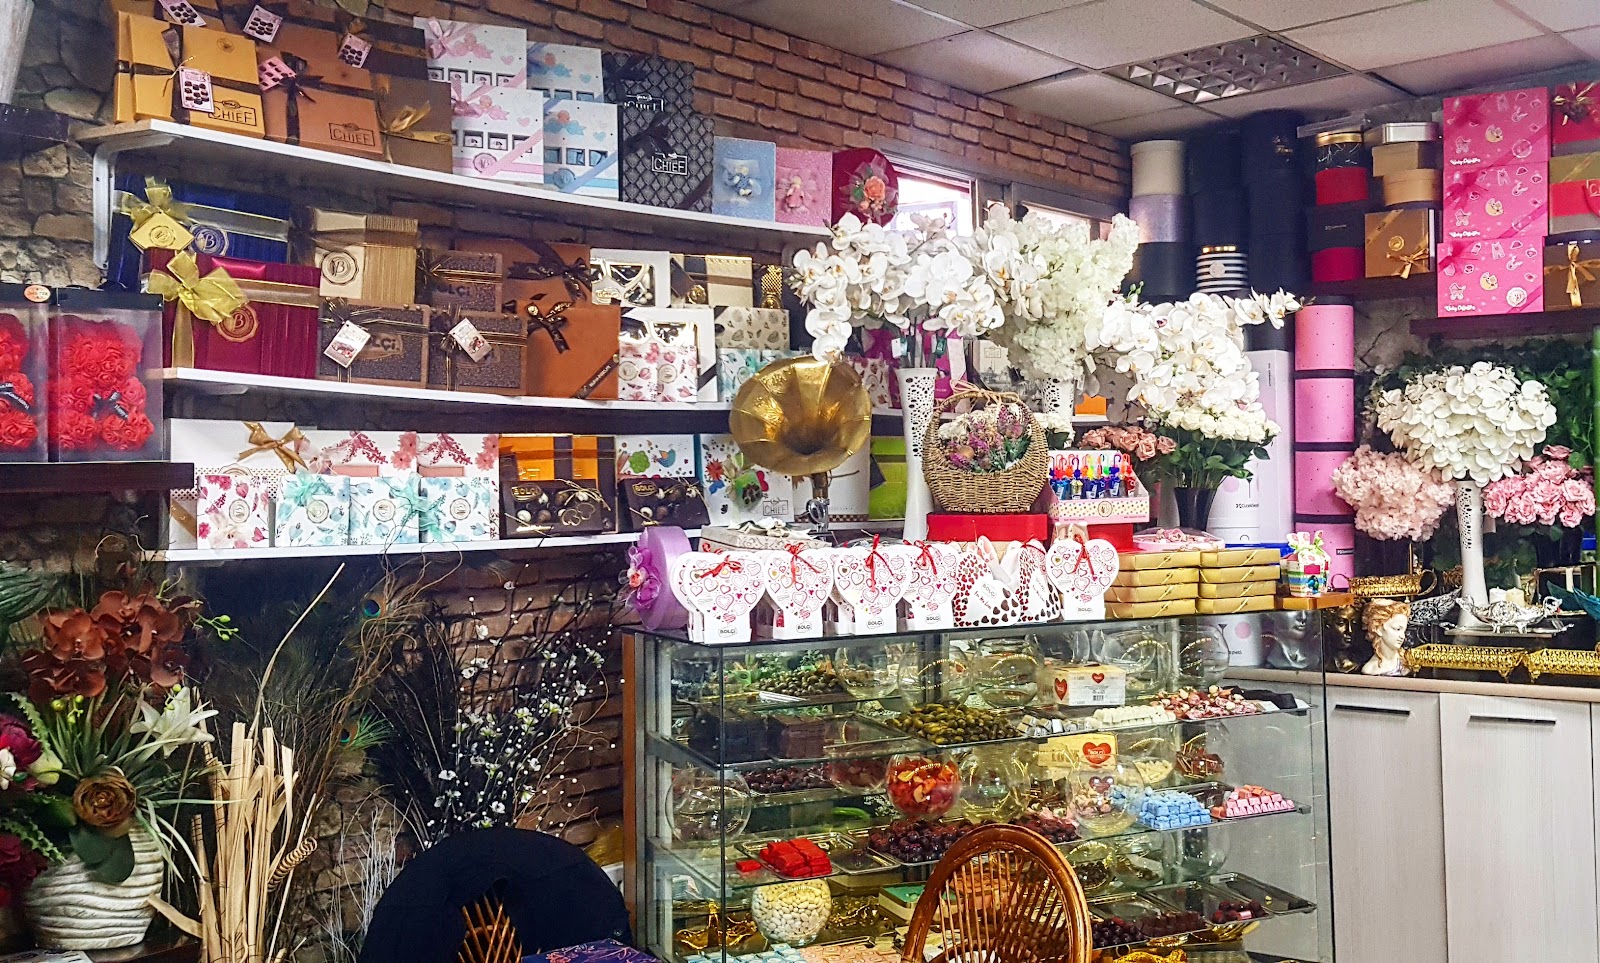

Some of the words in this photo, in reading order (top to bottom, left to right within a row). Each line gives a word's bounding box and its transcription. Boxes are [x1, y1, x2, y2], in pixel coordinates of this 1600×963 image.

[212, 106, 253, 124] CHIEF
[332, 129, 371, 145] CHIEF
[654, 157, 686, 173] CHIEF
[764, 503, 787, 515] CHIEF
